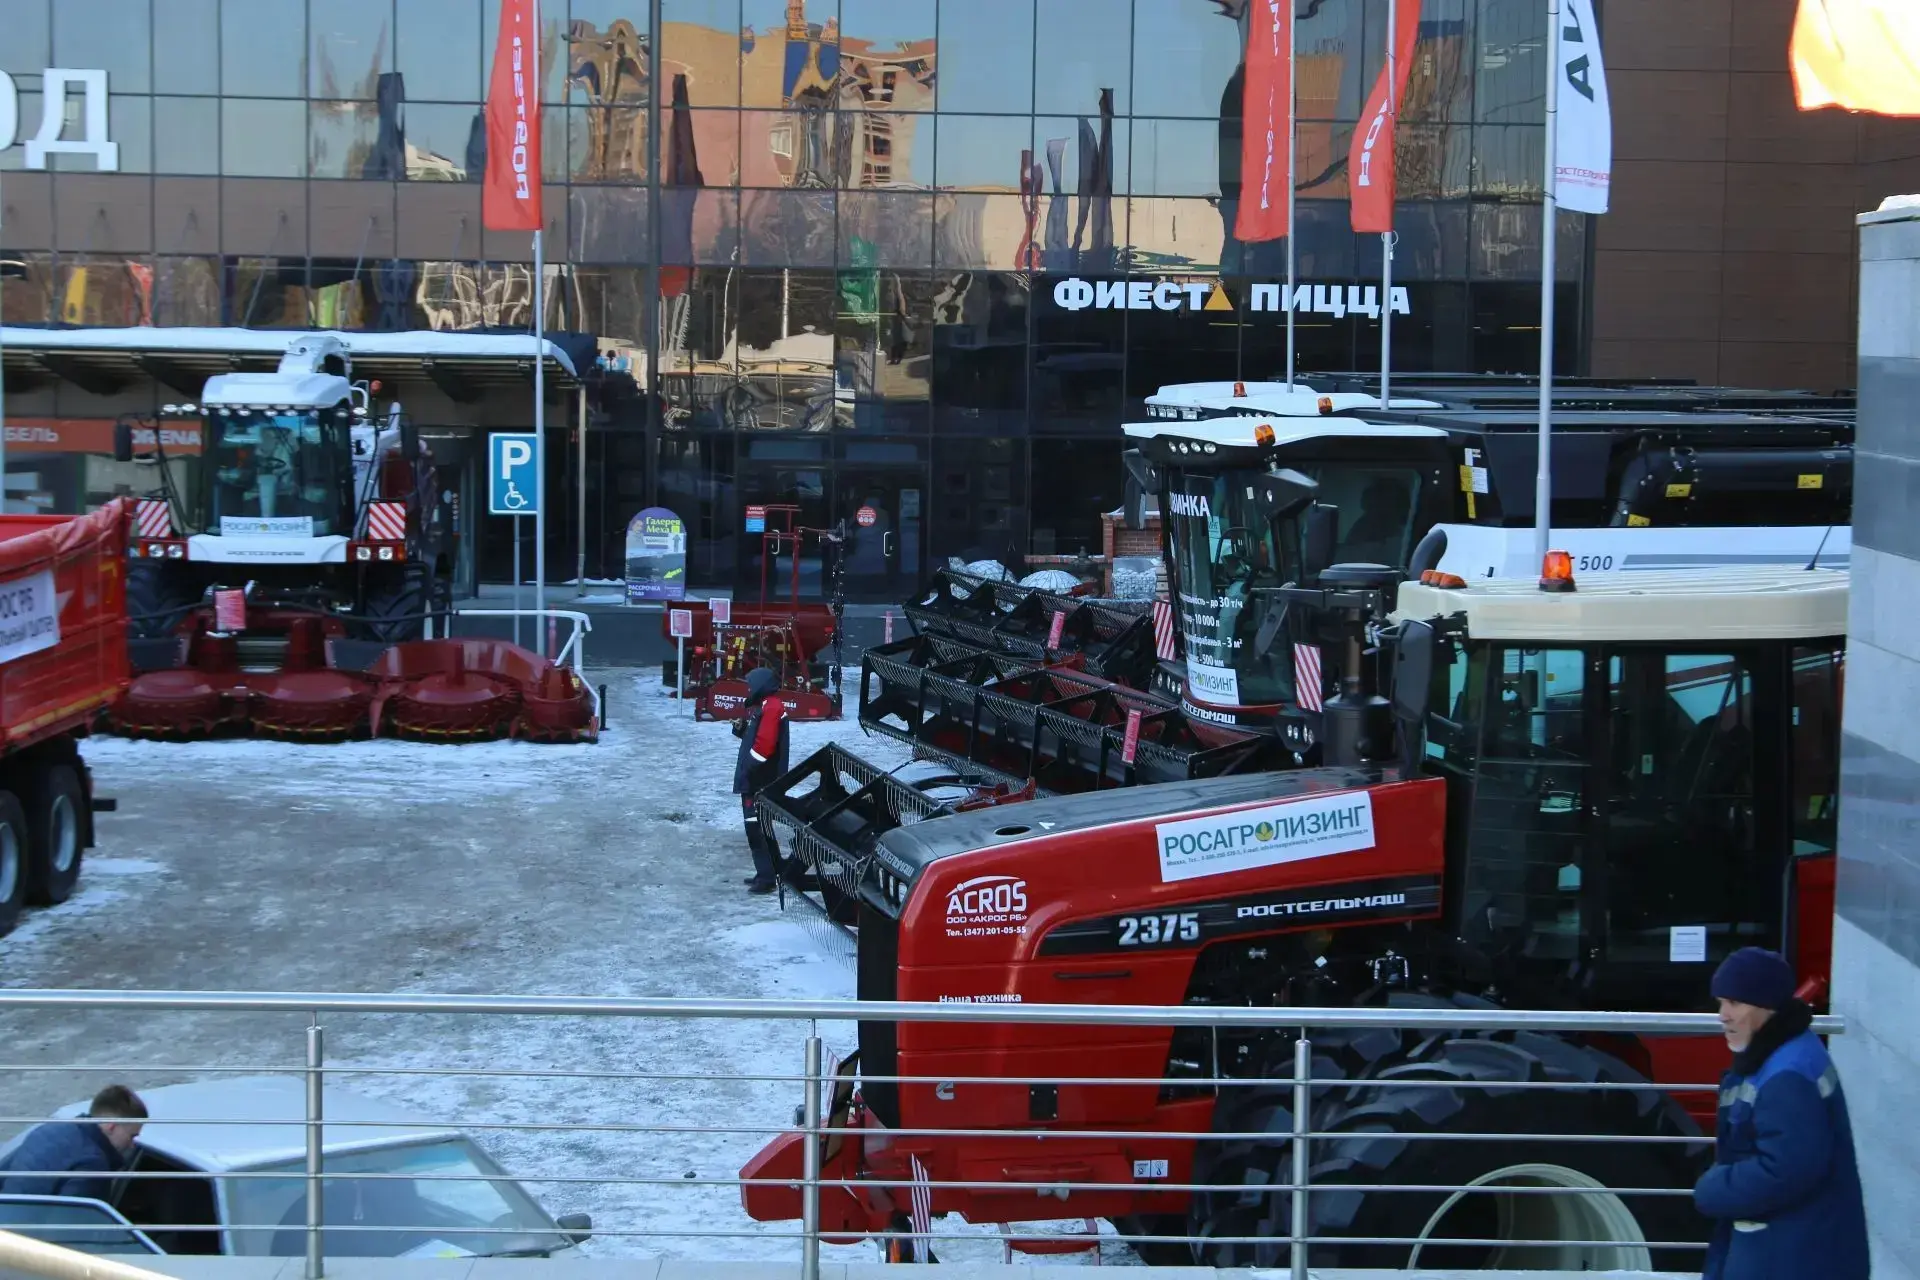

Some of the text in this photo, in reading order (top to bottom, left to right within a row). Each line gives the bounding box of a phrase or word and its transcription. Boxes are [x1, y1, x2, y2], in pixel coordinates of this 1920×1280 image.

[0, 68, 119, 172] Д
[1250, 283, 1411, 318] ПИЦЦА
[130, 429, 201, 445] ORENA
[502, 440, 531, 480] P
[645, 516, 681, 528] Галерея
[646, 524, 670, 534] Меха
[1579, 555, 1613, 571] 500
[1218, 596, 1230, 608] 30
[1226, 636, 1232, 648] 3
[1164, 805, 1366, 858] РОСАГРОЛИЗИНГ
[946, 881, 1027, 915] ACROS
[1237, 893, 1405, 918] РОСТСЕЛЬМАШ
[946, 926, 1027, 937] Тел. (347) 201-05-55
[1118, 912, 1200, 946] 2375
[939, 993, 1022, 1003] Наша техника
